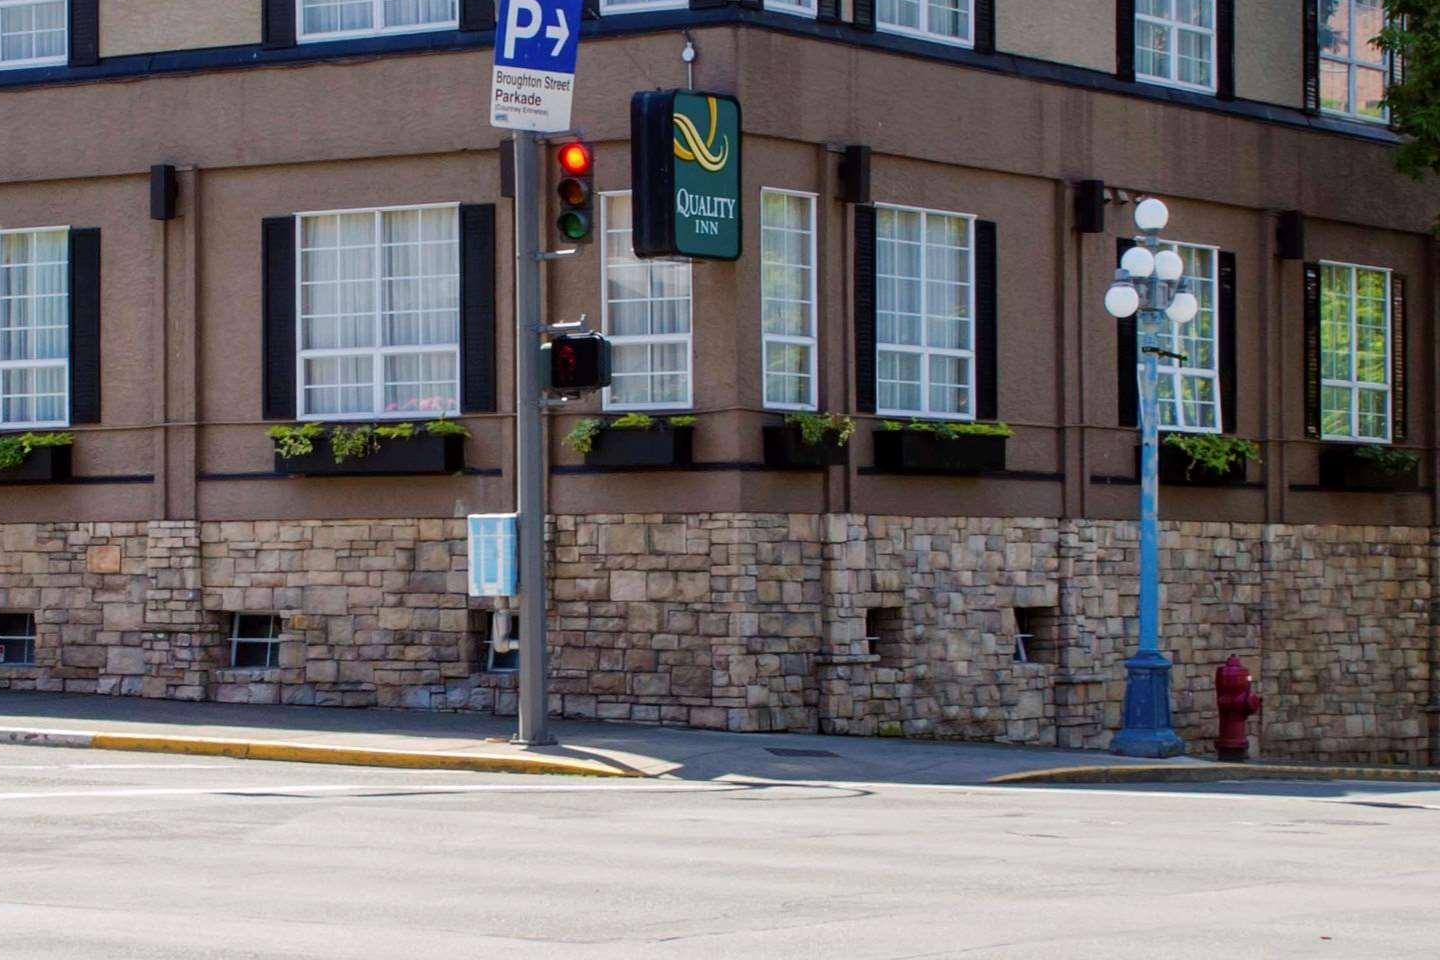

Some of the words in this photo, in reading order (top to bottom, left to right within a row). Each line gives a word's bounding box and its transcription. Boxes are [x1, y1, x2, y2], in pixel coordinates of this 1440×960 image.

[496, 71, 542, 89] Broughton
[544, 76, 570, 92] Street
[496, 89, 542, 106] Parkade
[676, 187, 736, 219] QUALITY
[695, 219, 719, 235] INN
